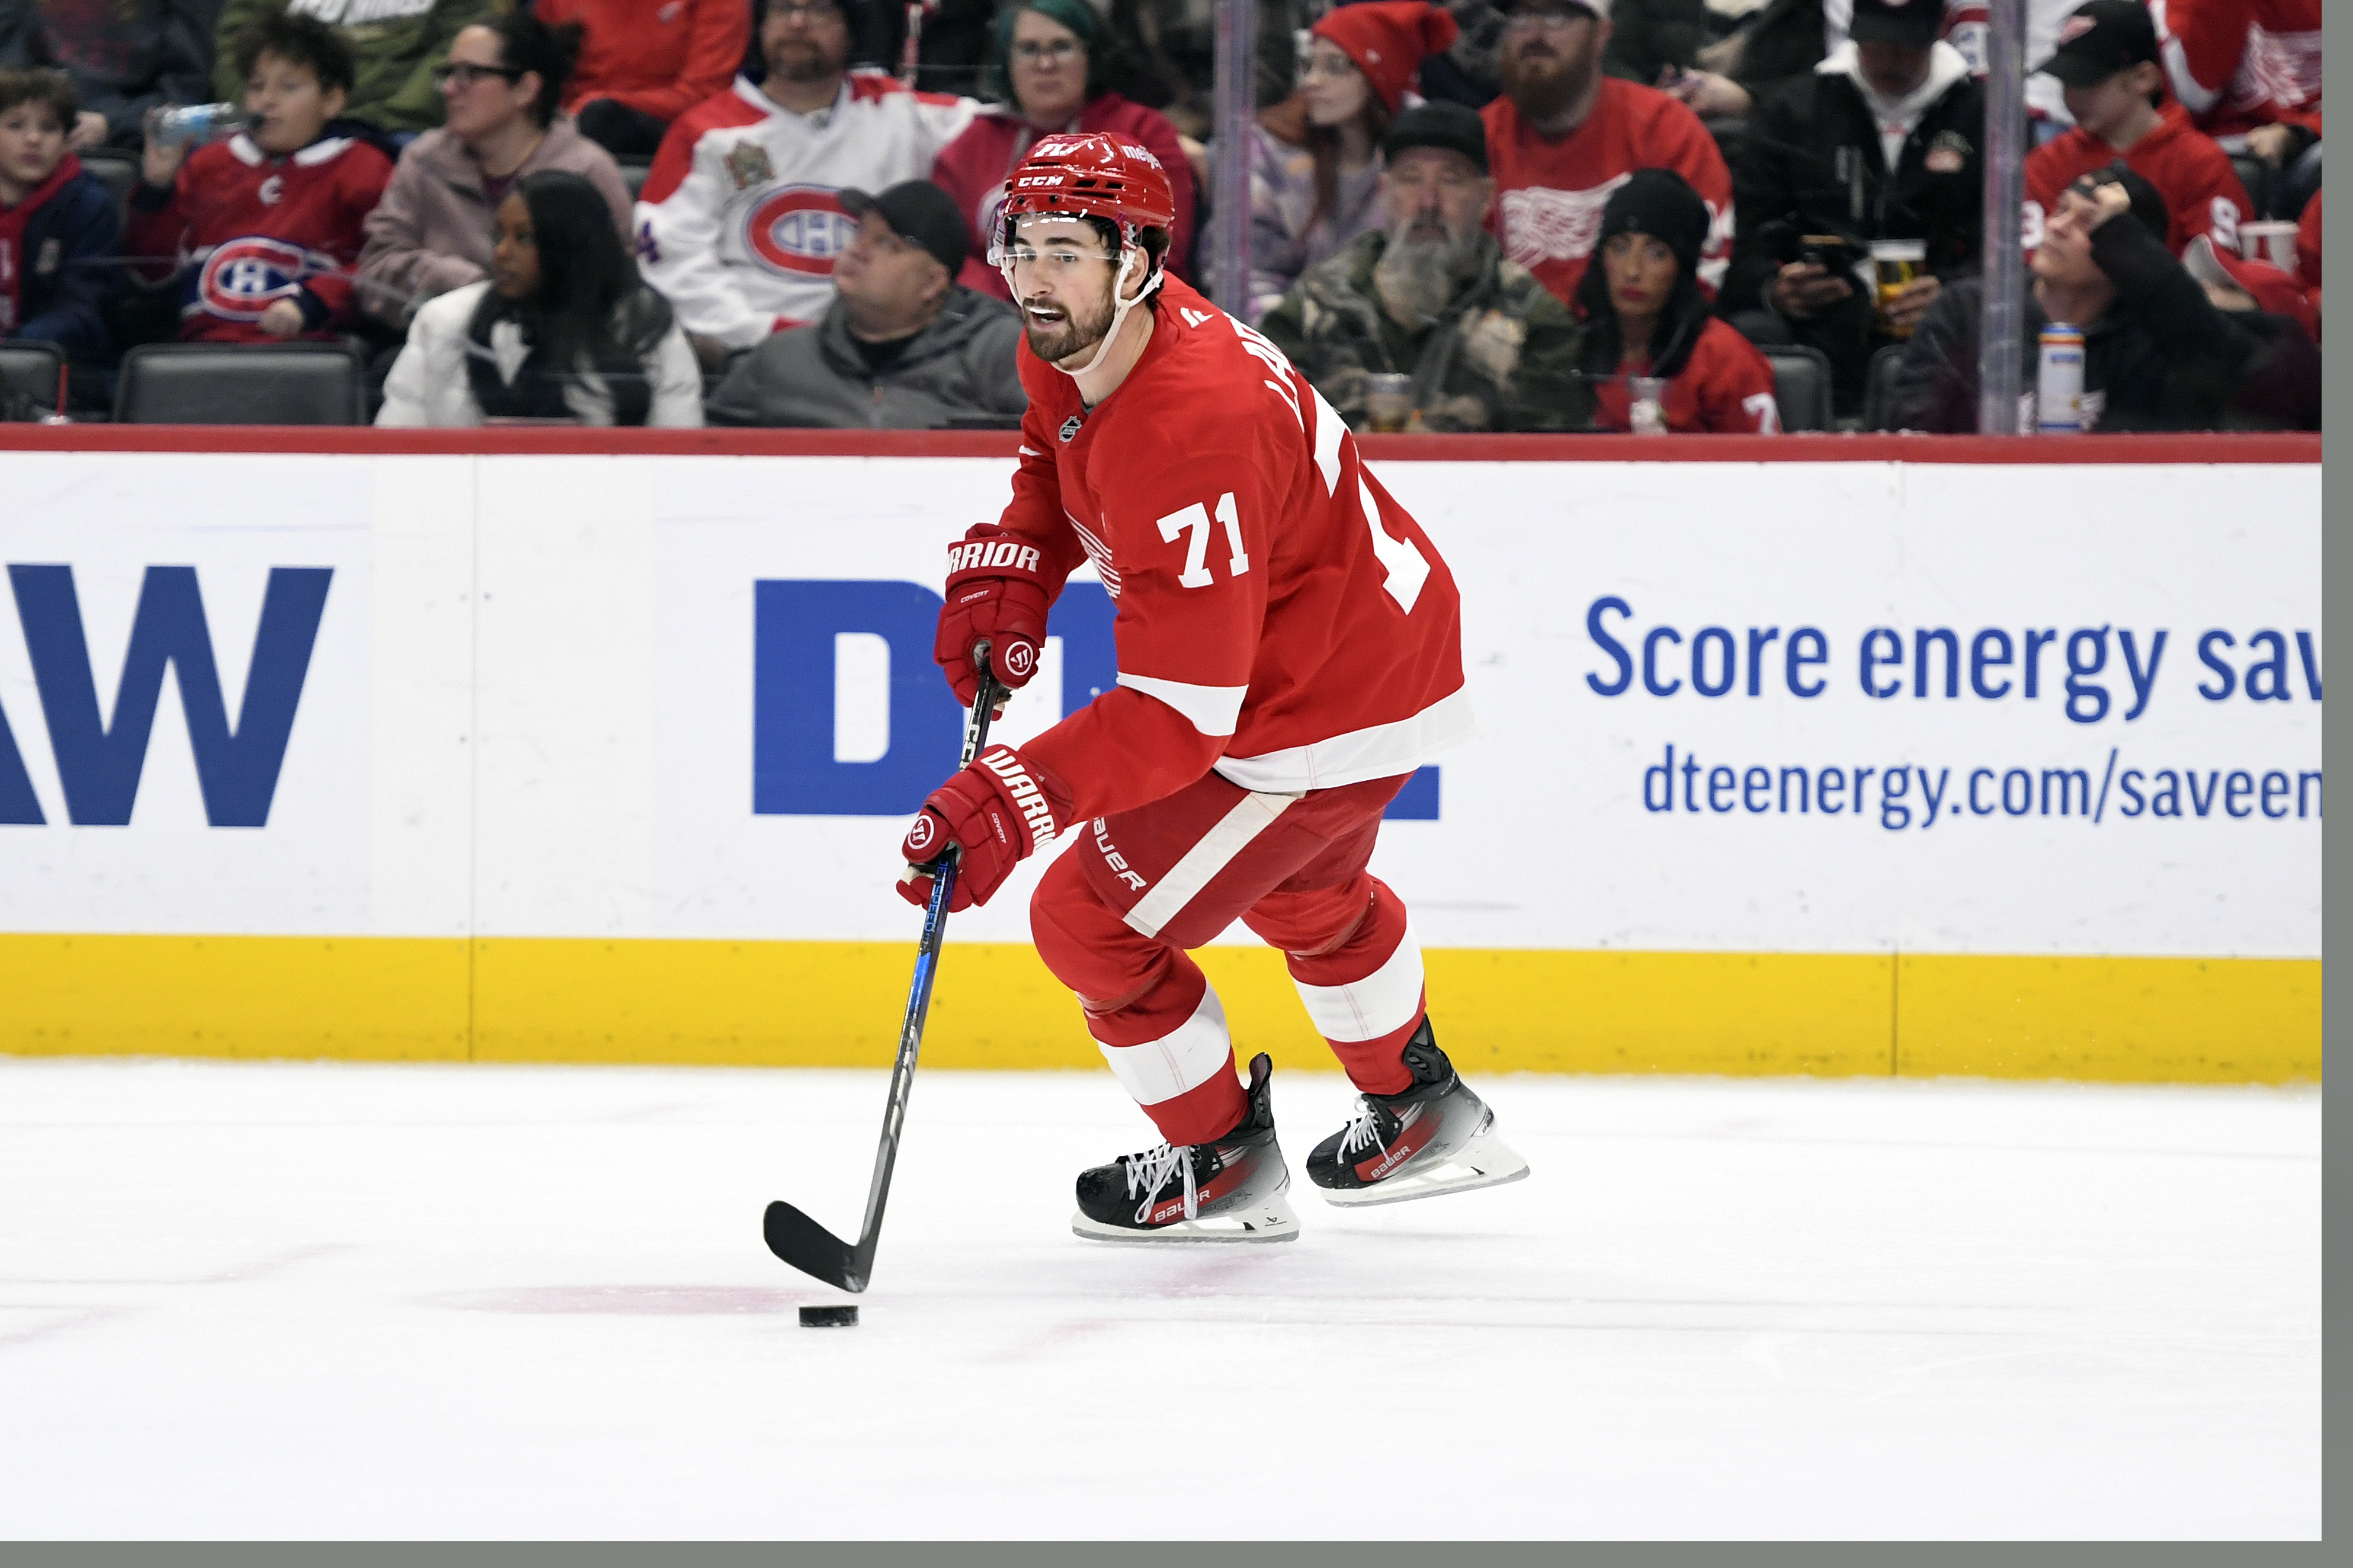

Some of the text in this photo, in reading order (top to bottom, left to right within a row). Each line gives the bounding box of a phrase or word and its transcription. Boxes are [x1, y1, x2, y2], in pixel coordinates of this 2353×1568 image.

[1018, 176, 1065, 187] CCM
[948, 541, 1041, 573] RRIOR
[1156, 492, 1249, 588] 71
[1585, 596, 1829, 699] Score
[1859, 626, 2169, 724] energy
[980, 749, 1056, 851] WARRI
[1643, 744, 2322, 830] dteenergy.com/saveen
[991, 813, 1007, 844] COVERT
[1094, 817, 1147, 891] AUER
